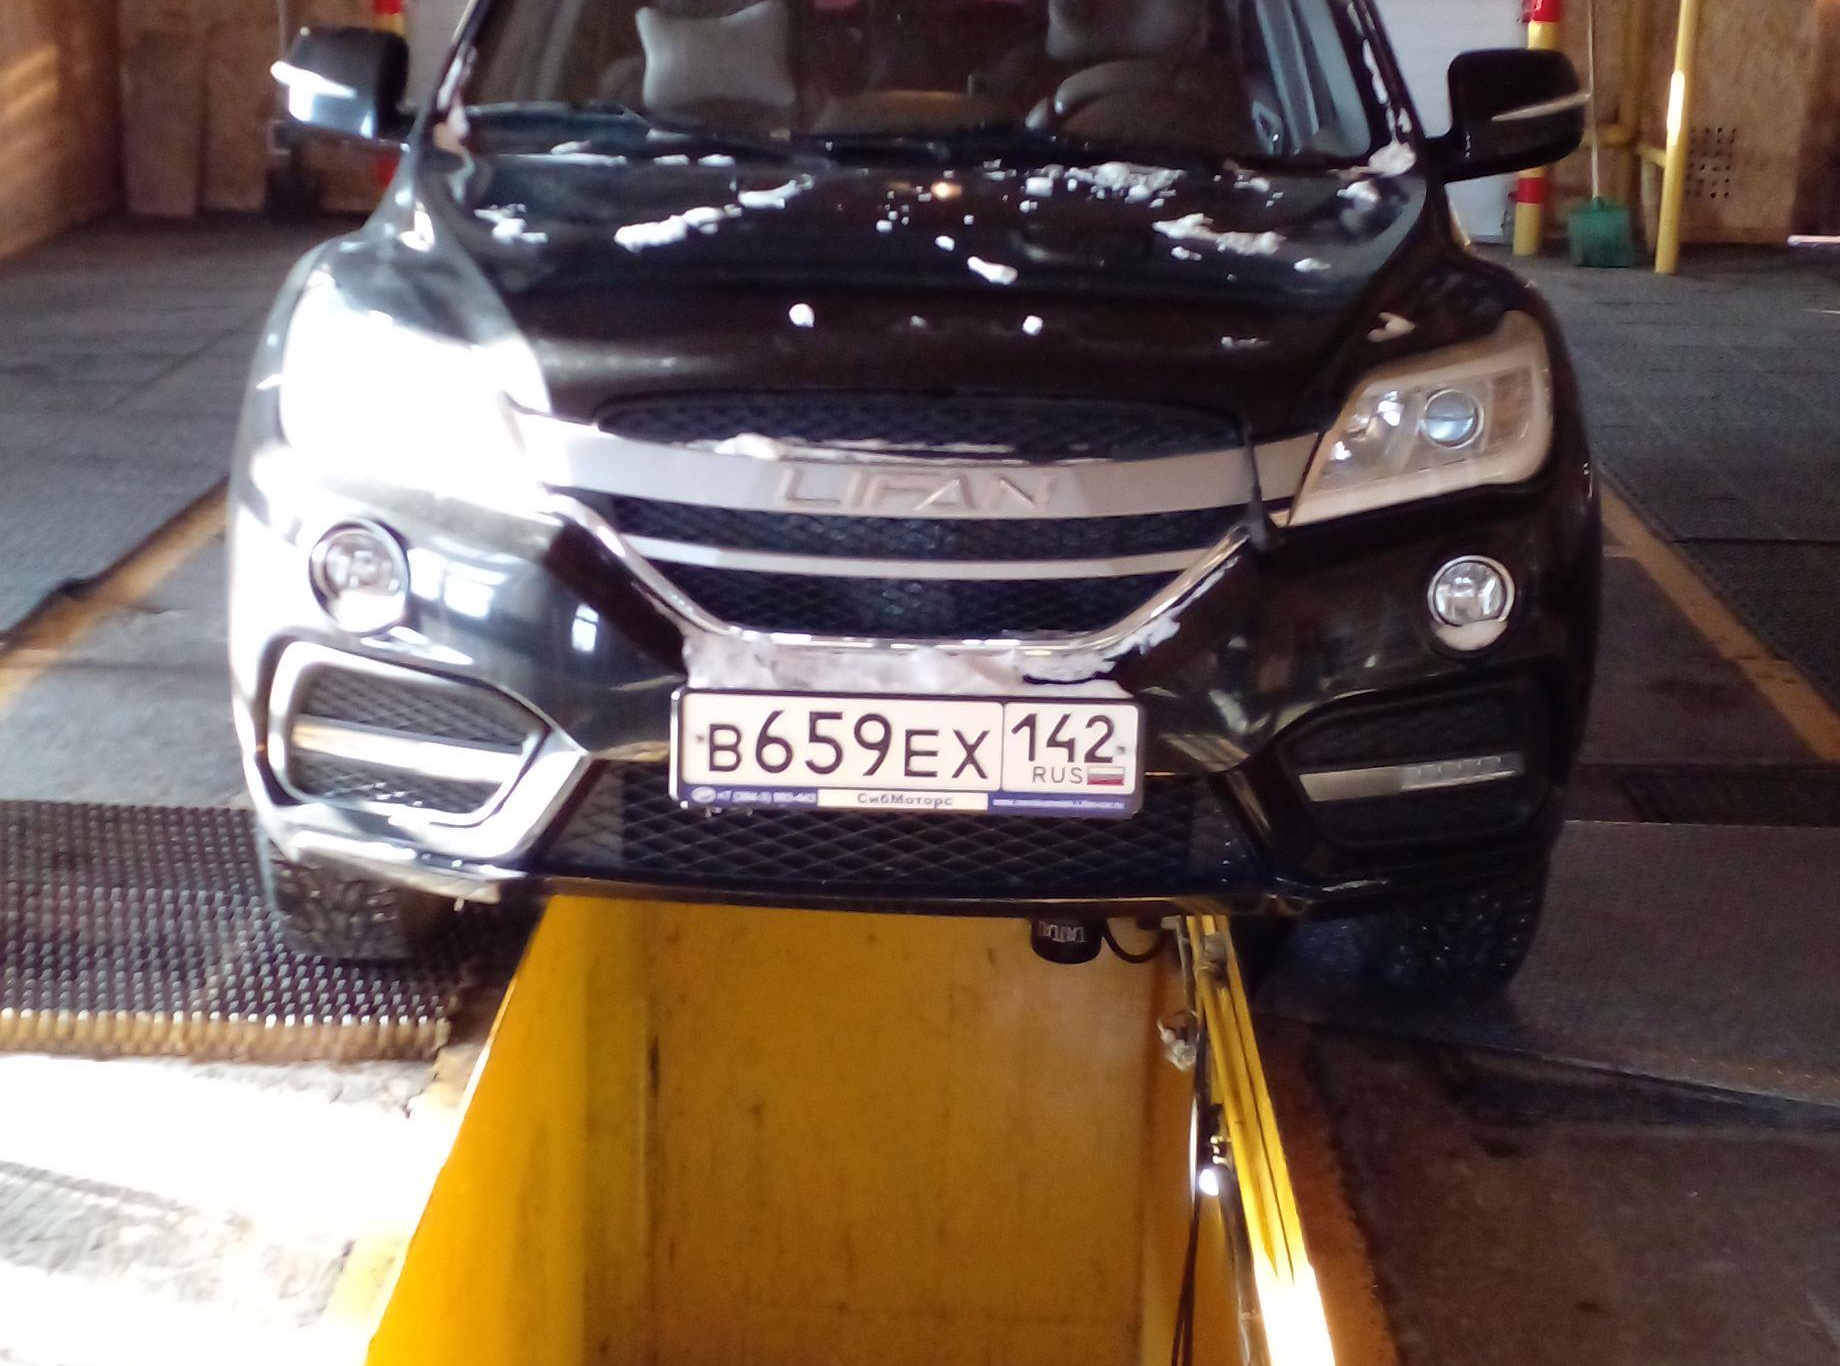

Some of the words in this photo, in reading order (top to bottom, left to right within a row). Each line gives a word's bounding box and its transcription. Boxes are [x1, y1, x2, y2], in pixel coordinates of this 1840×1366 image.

[775, 467, 1059, 511] LIFAN
[1011, 713, 1114, 764] 142
[1032, 766, 1083, 784] RUS
[857, 792, 954, 809] СибМоторс
